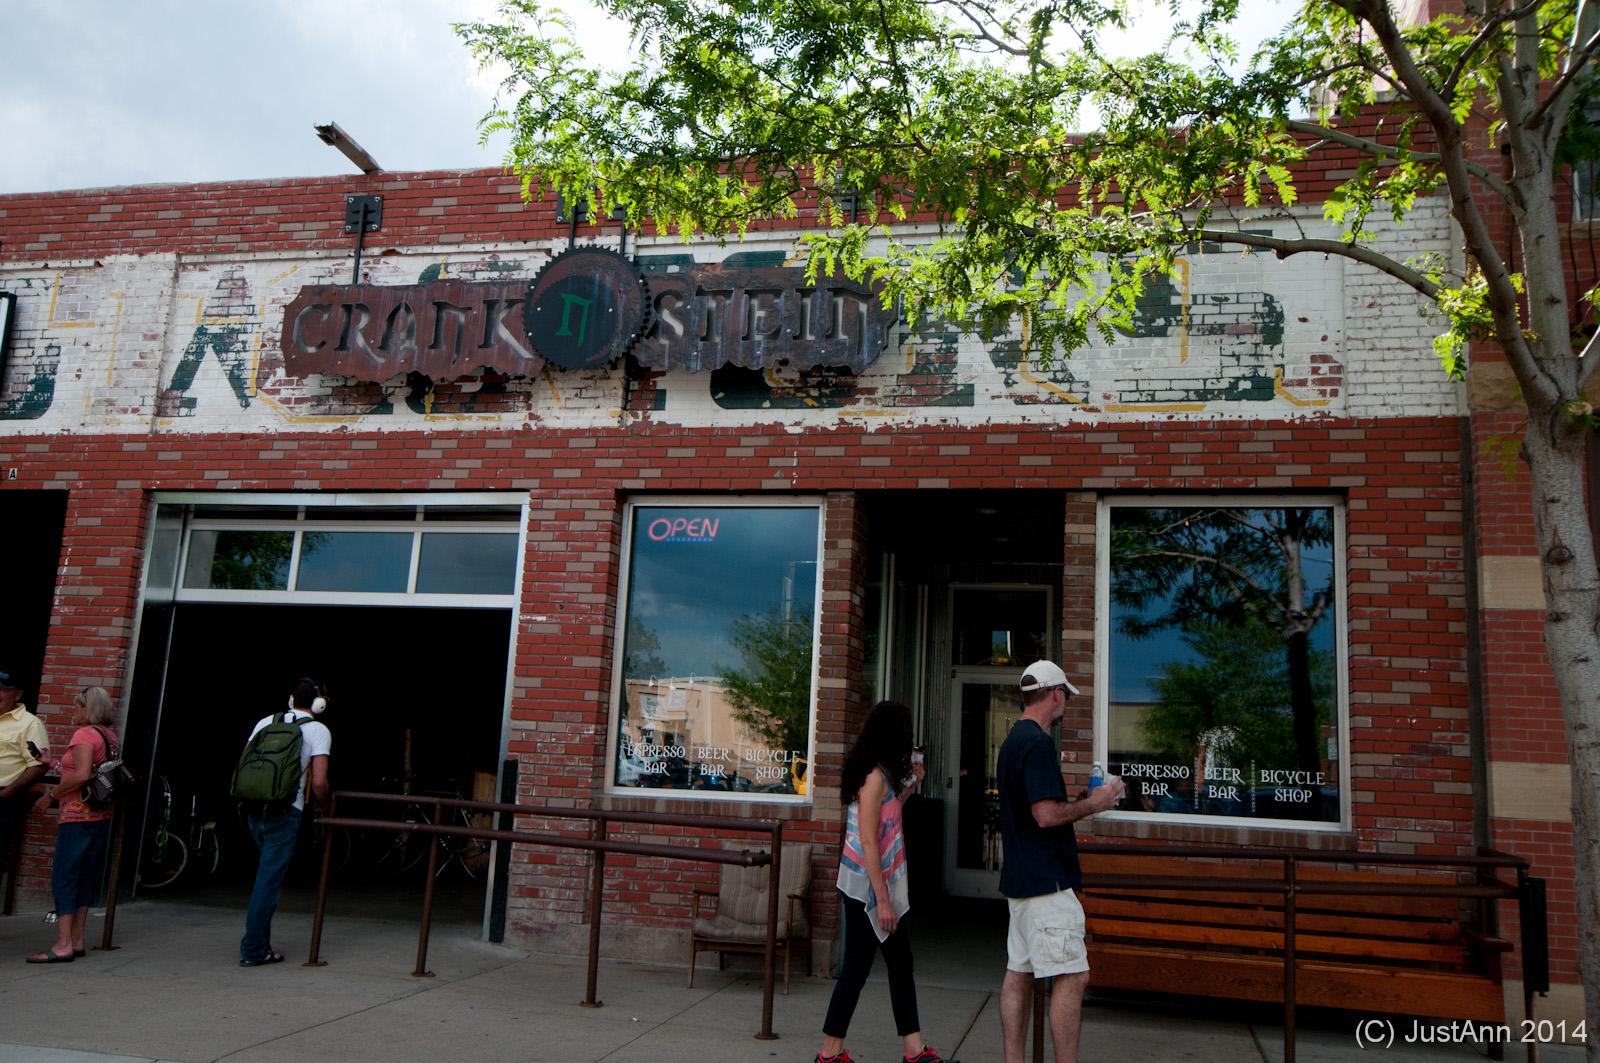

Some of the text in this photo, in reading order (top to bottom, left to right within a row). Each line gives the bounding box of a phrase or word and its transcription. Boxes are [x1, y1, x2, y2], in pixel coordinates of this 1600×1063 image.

[291, 297, 536, 366] CRANK
[648, 517, 719, 542] OPEN
[627, 743, 686, 759] ESPRESSO
[698, 746, 732, 762] BEER
[746, 749, 801, 764] BICYCLE
[643, 761, 671, 776] BAR
[700, 764, 729, 779] BAR
[755, 766, 788, 779] SHOP
[1121, 763, 1190, 780] ESPRESSO
[1205, 767, 1246, 785] BEER
[1261, 769, 1326, 786] BICYCLE
[1141, 782, 1174, 799] BAR
[1208, 785, 1242, 802] BAR
[1274, 788, 1312, 803] SHOP
